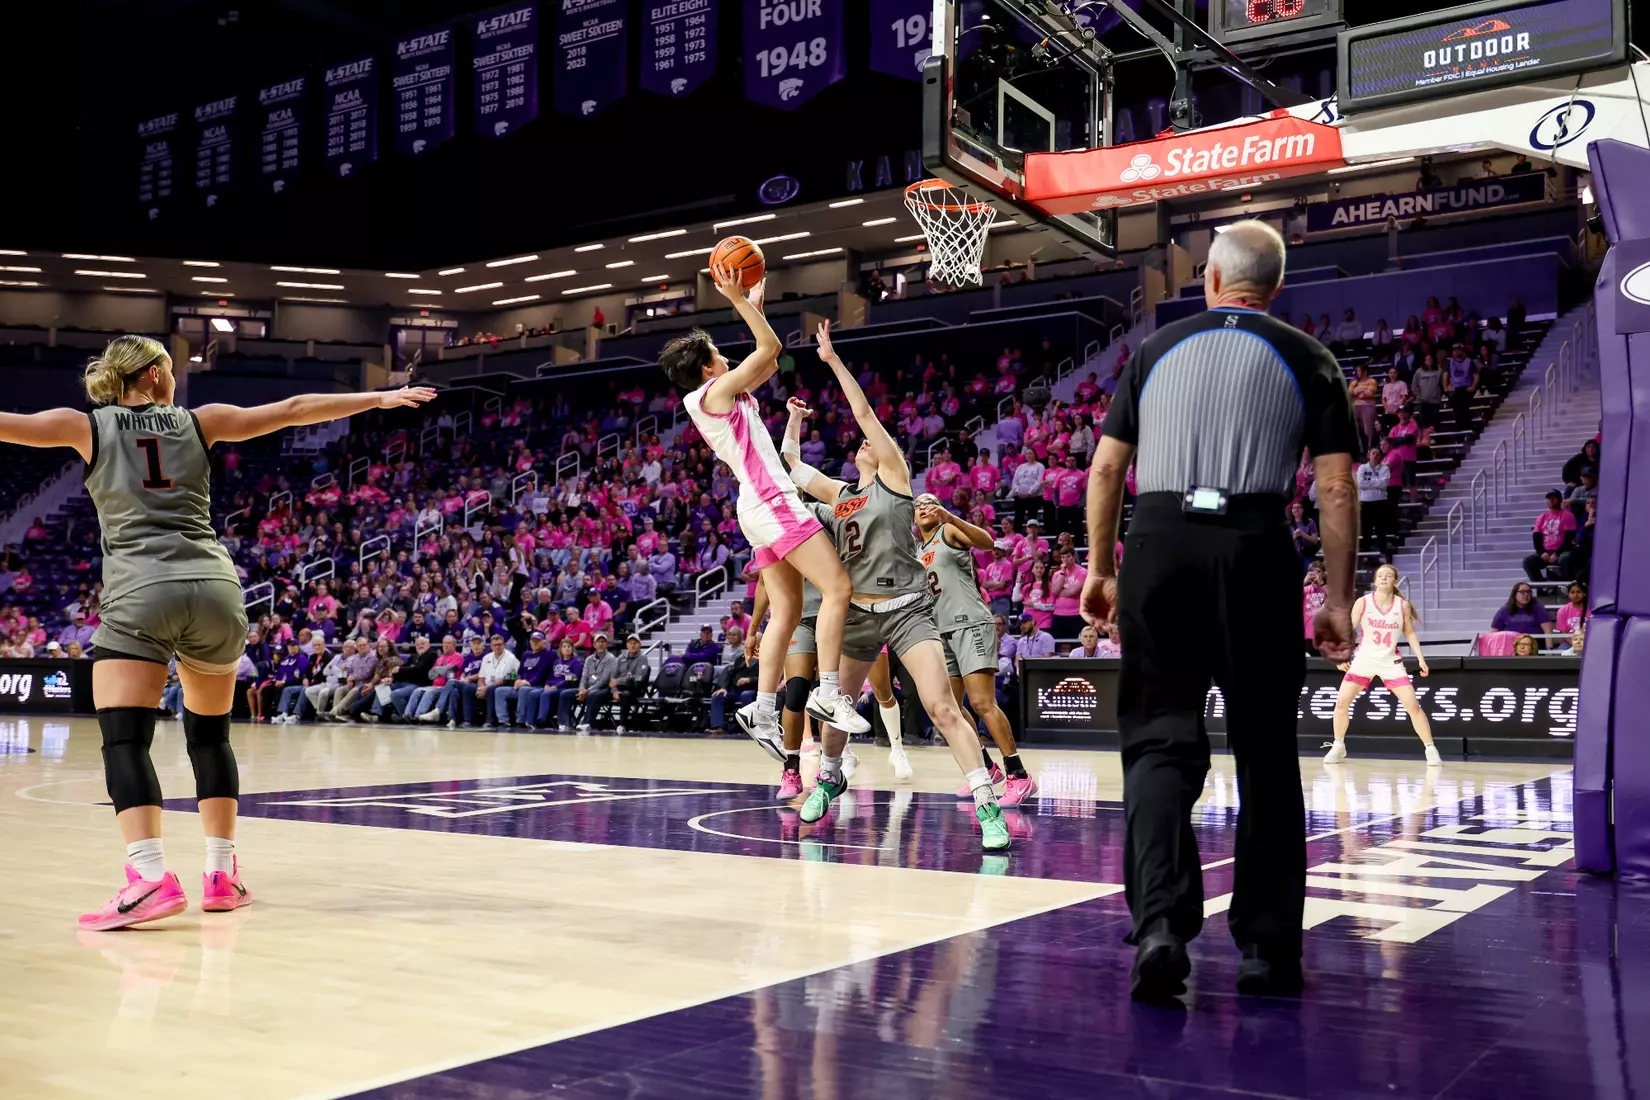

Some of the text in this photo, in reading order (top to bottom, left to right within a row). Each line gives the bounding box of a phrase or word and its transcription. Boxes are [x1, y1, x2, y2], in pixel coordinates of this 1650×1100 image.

[651, 0, 708, 19] ELITE EIGHT
[760, 0, 822, 30] FOUR
[477, 8, 532, 34] K-STATE
[655, 22, 675, 35] 1951
[684, 14, 706, 28] 1964
[559, 19, 623, 46] SWEET SIXTEEN
[655, 34, 676, 47] 1958
[684, 27, 706, 40] 1972
[397, 31, 450, 55] K-STATE
[566, 46, 587, 59] 2018
[655, 46, 676, 59] 1959
[684, 39, 706, 52] 1973
[1424, 32, 1530, 68] OUTDOOR
[473, 44, 533, 68] SWEET SIXTEEN
[566, 57, 586, 70] 2023
[654, 58, 675, 72] 1961
[684, 51, 706, 65] 1975
[756, 37, 827, 78] 1948
[325, 58, 373, 82] K-STATE
[393, 65, 450, 87] SWEET SIXTEEN
[482, 69, 499, 81] 1972
[1415, 76, 1443, 86] Member
[1443, 71, 1461, 81] FDIC
[1465, 68, 1485, 78] Equal
[1486, 63, 1514, 74] Housing
[259, 78, 304, 101] K-STATE
[482, 80, 499, 92] 1973
[195, 96, 236, 119] K-STATE
[481, 92, 499, 104] 1975
[480, 103, 498, 115] 1977
[114, 412, 179, 432] WHITING
[135, 437, 174, 490] 1
[834, 496, 869, 519] OSU
[845, 520, 862, 552] 2
[928, 571, 942, 596] 2
[1367, 617, 1399, 629] Wildcats
[1373, 630, 1392, 648] 34
[1038, 688, 1097, 708] Kansas
